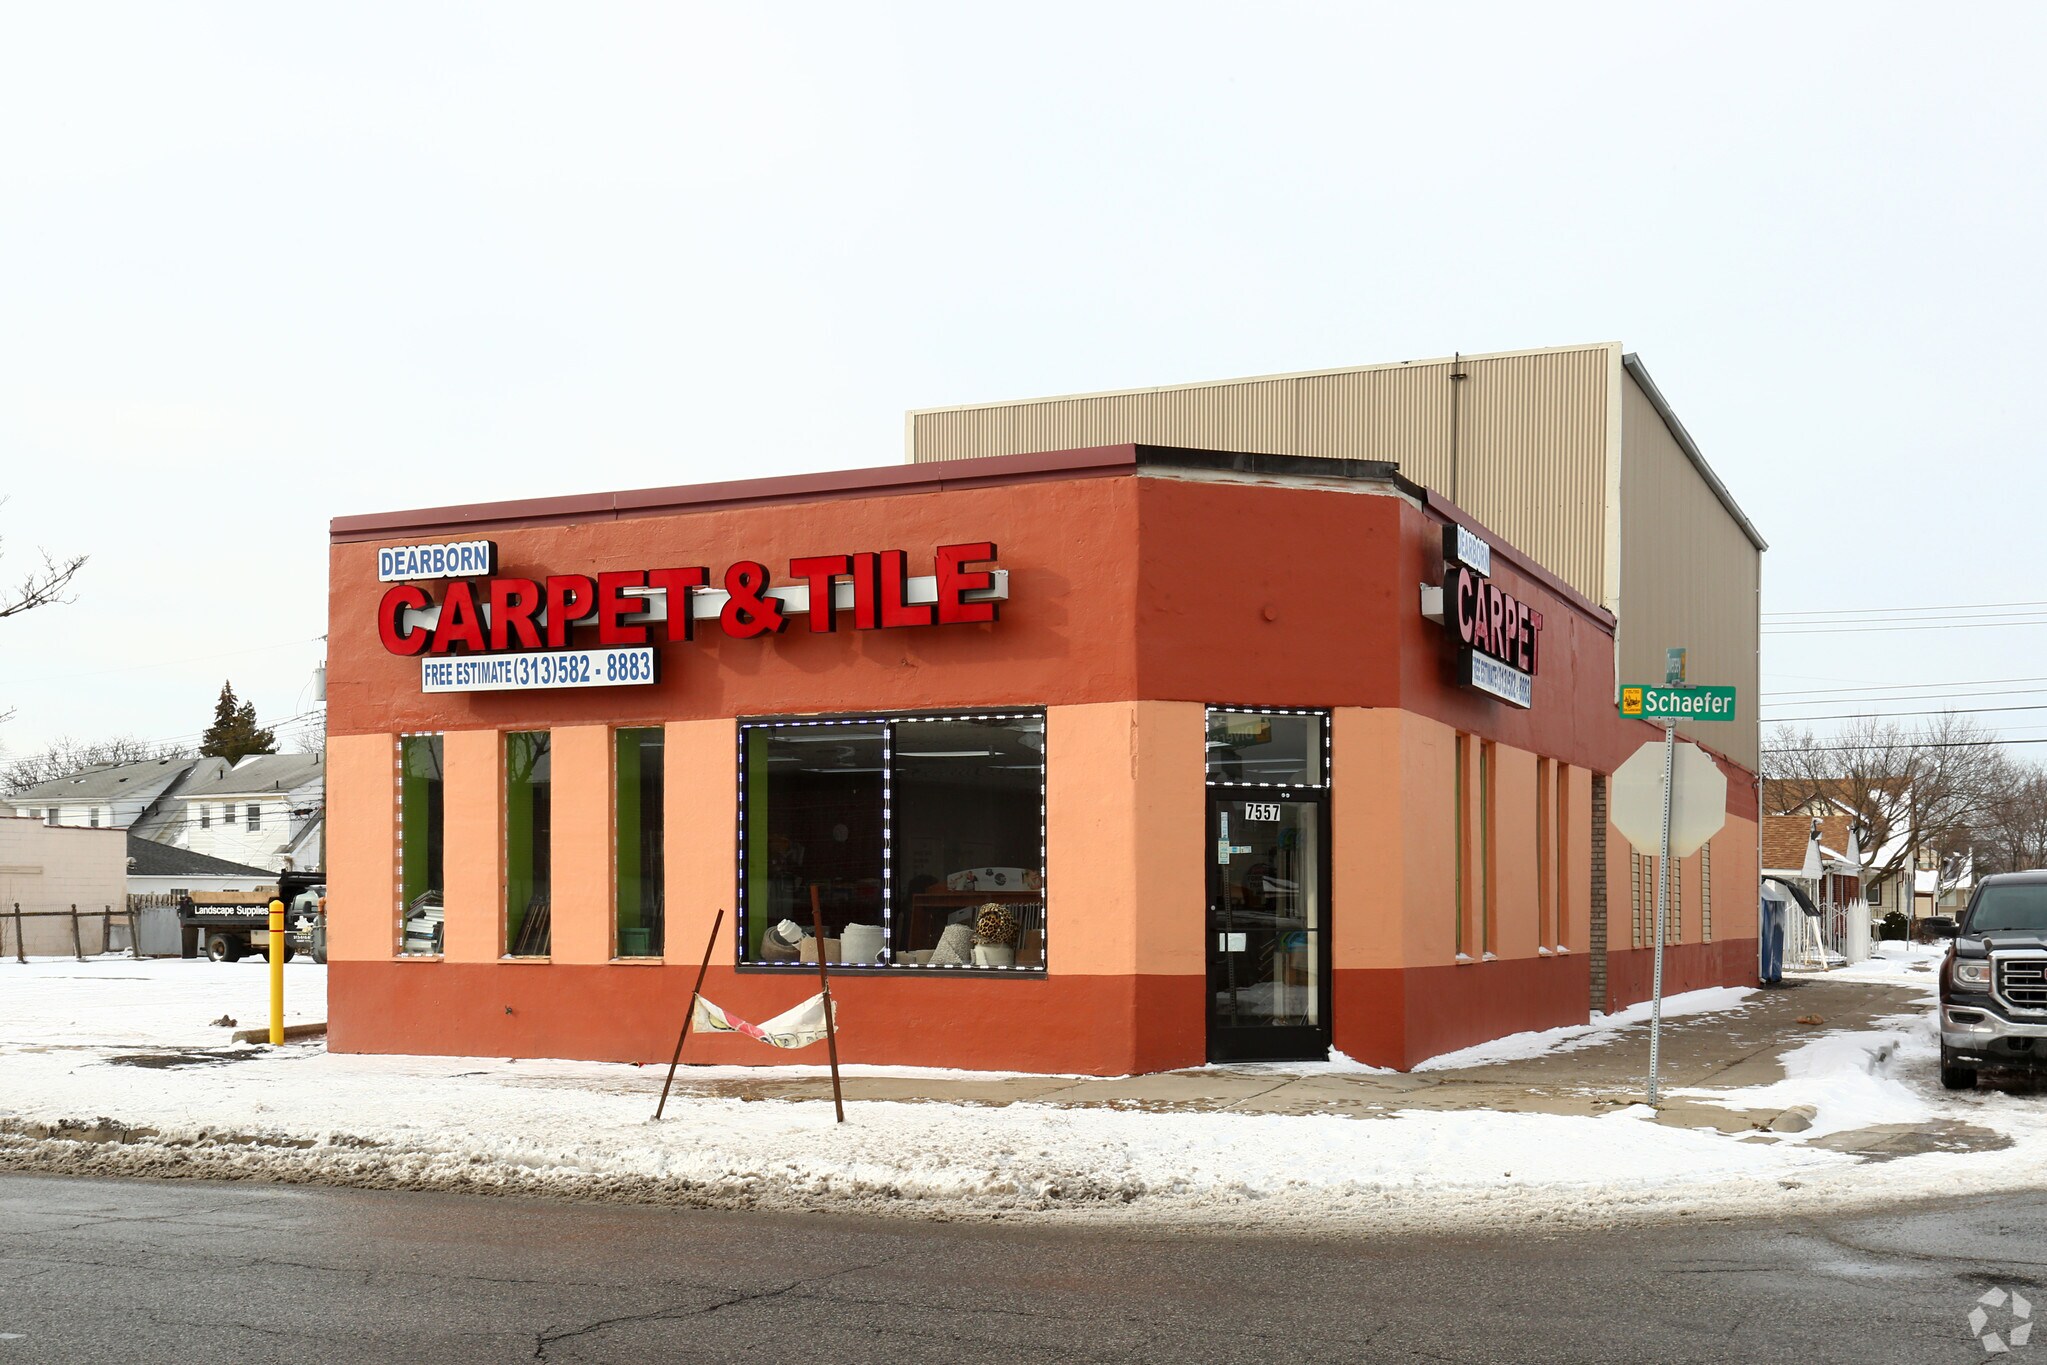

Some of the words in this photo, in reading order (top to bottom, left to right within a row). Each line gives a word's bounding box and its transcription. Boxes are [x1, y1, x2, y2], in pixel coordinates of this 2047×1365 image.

[381, 545, 487, 576] DEARBORN
[378, 567, 709, 656] CARPET
[720, 561, 788, 639] &
[790, 542, 997, 633] TILE
[1458, 567, 1543, 675] CARPET
[425, 658, 452, 686] FREE
[456, 659, 512, 685] ESTIMATE
[607, 652, 650, 682] 8883
[1645, 691, 1732, 713] Schaefer
[1247, 804, 1280, 821] 7557
[194, 905, 235, 916] Landscape
[236, 905, 269, 917] Supplies
